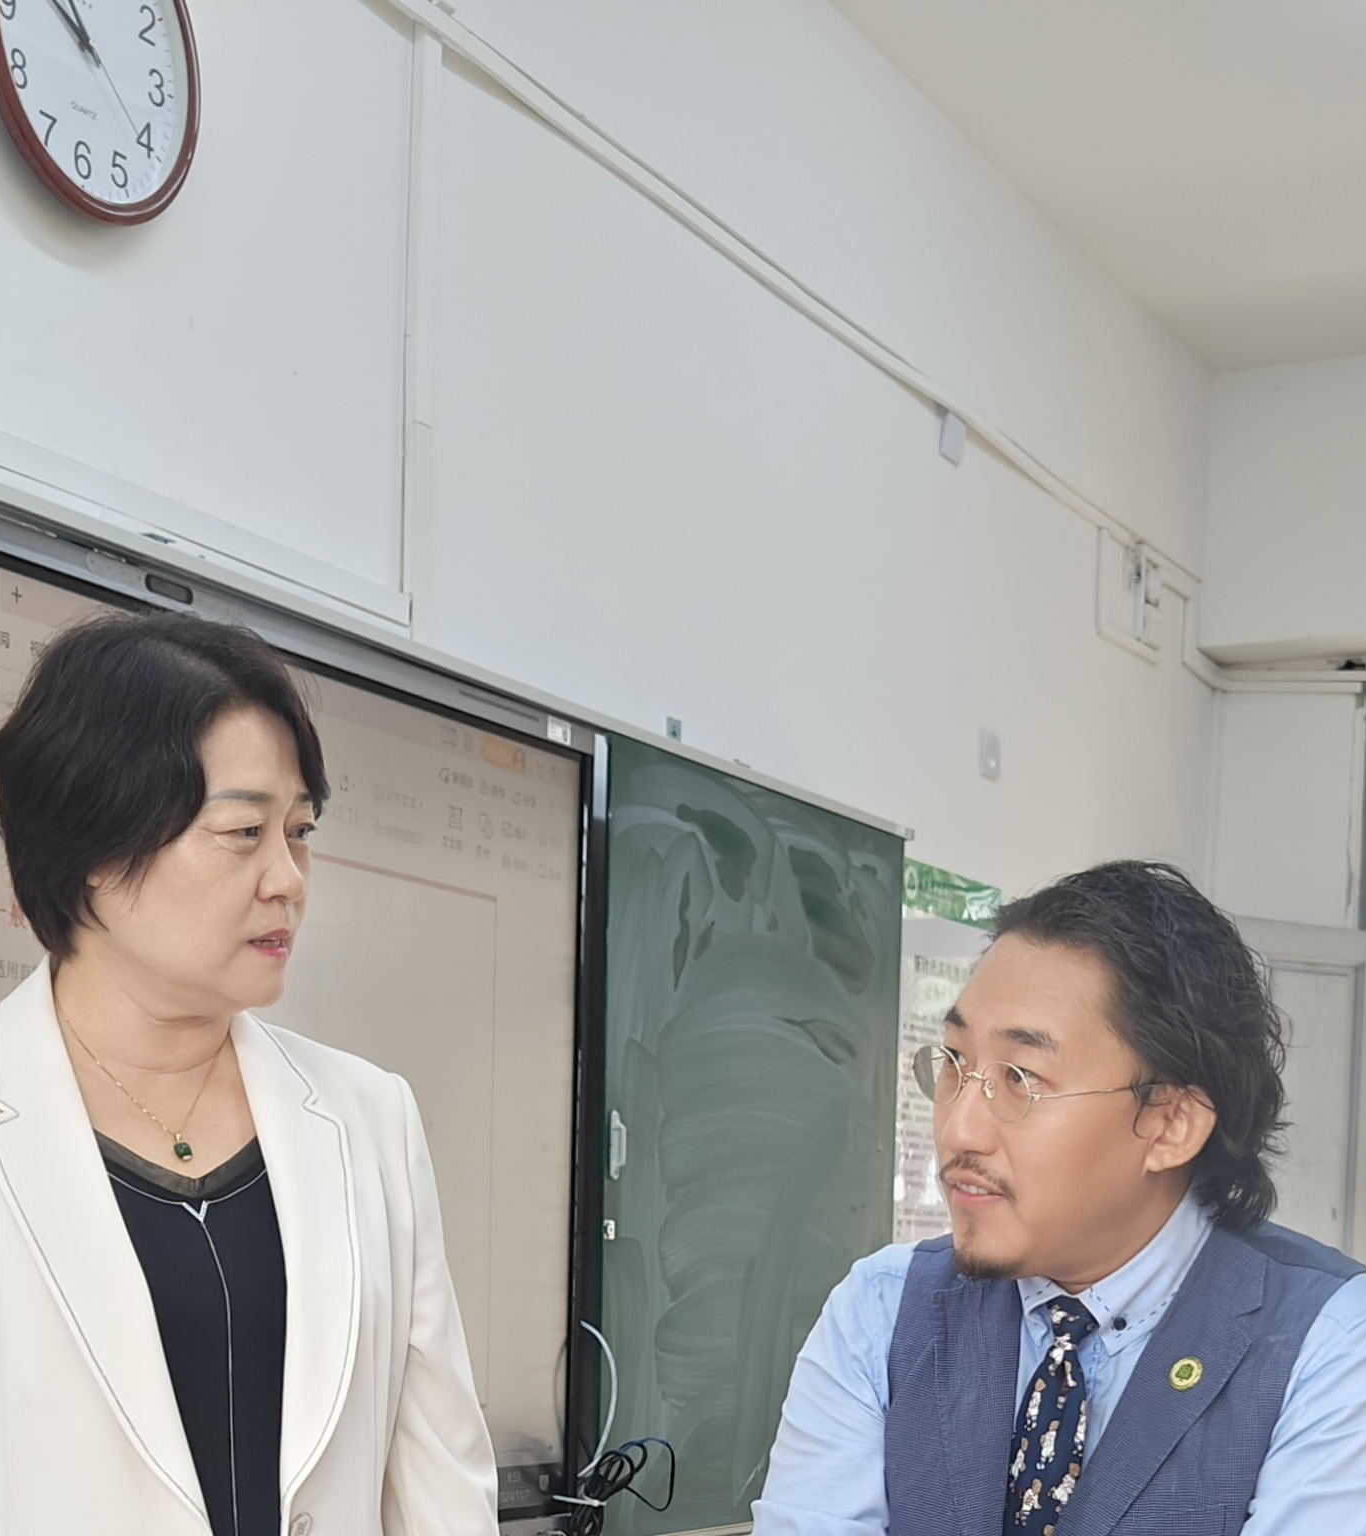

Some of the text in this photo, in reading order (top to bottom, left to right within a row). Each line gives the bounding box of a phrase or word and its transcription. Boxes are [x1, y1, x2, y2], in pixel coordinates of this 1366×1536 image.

[138, 4, 156, 47] 2
[11, 48, 28, 89] 8
[148, 68, 165, 107] 3
[39, 109, 58, 147] 7
[70, 101, 98, 121] QUARTZ
[74, 140, 92, 180] 6
[136, 122, 154, 159] 4
[111, 150, 128, 189] 5
